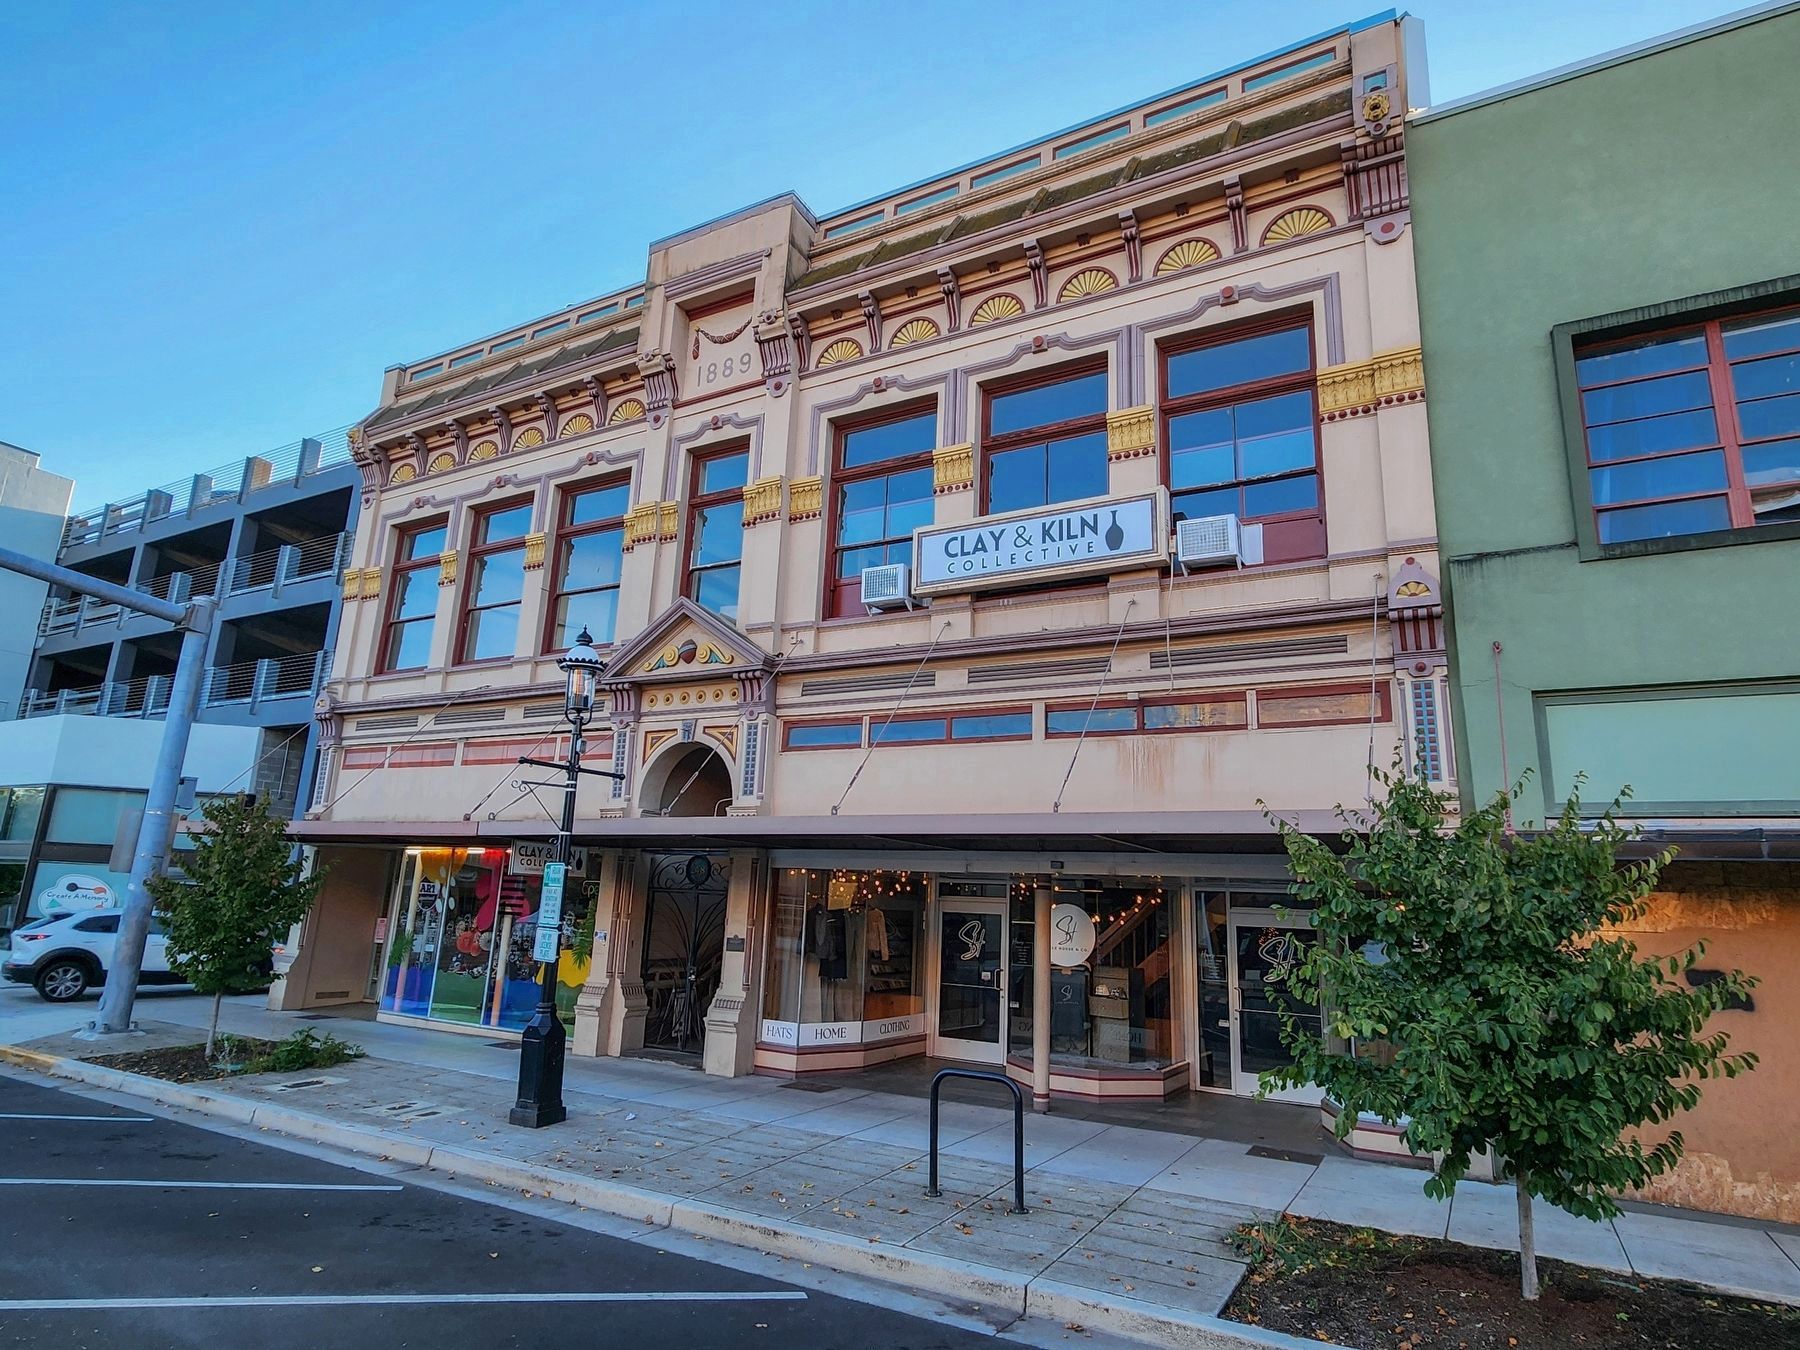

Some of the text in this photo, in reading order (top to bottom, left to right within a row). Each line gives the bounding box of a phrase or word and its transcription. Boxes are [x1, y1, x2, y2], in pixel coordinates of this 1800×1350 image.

[697, 352, 752, 387] 1889
[944, 513, 1099, 558] CLAY & KILN
[947, 541, 1095, 574] COLLECTIVE
[518, 846, 544, 858] CLAY
[545, 848, 553, 859] &
[46, 891, 72, 899] Create
[80, 893, 109, 903] Memory
[766, 1020, 910, 1040] HATS HOME CLOTHING
